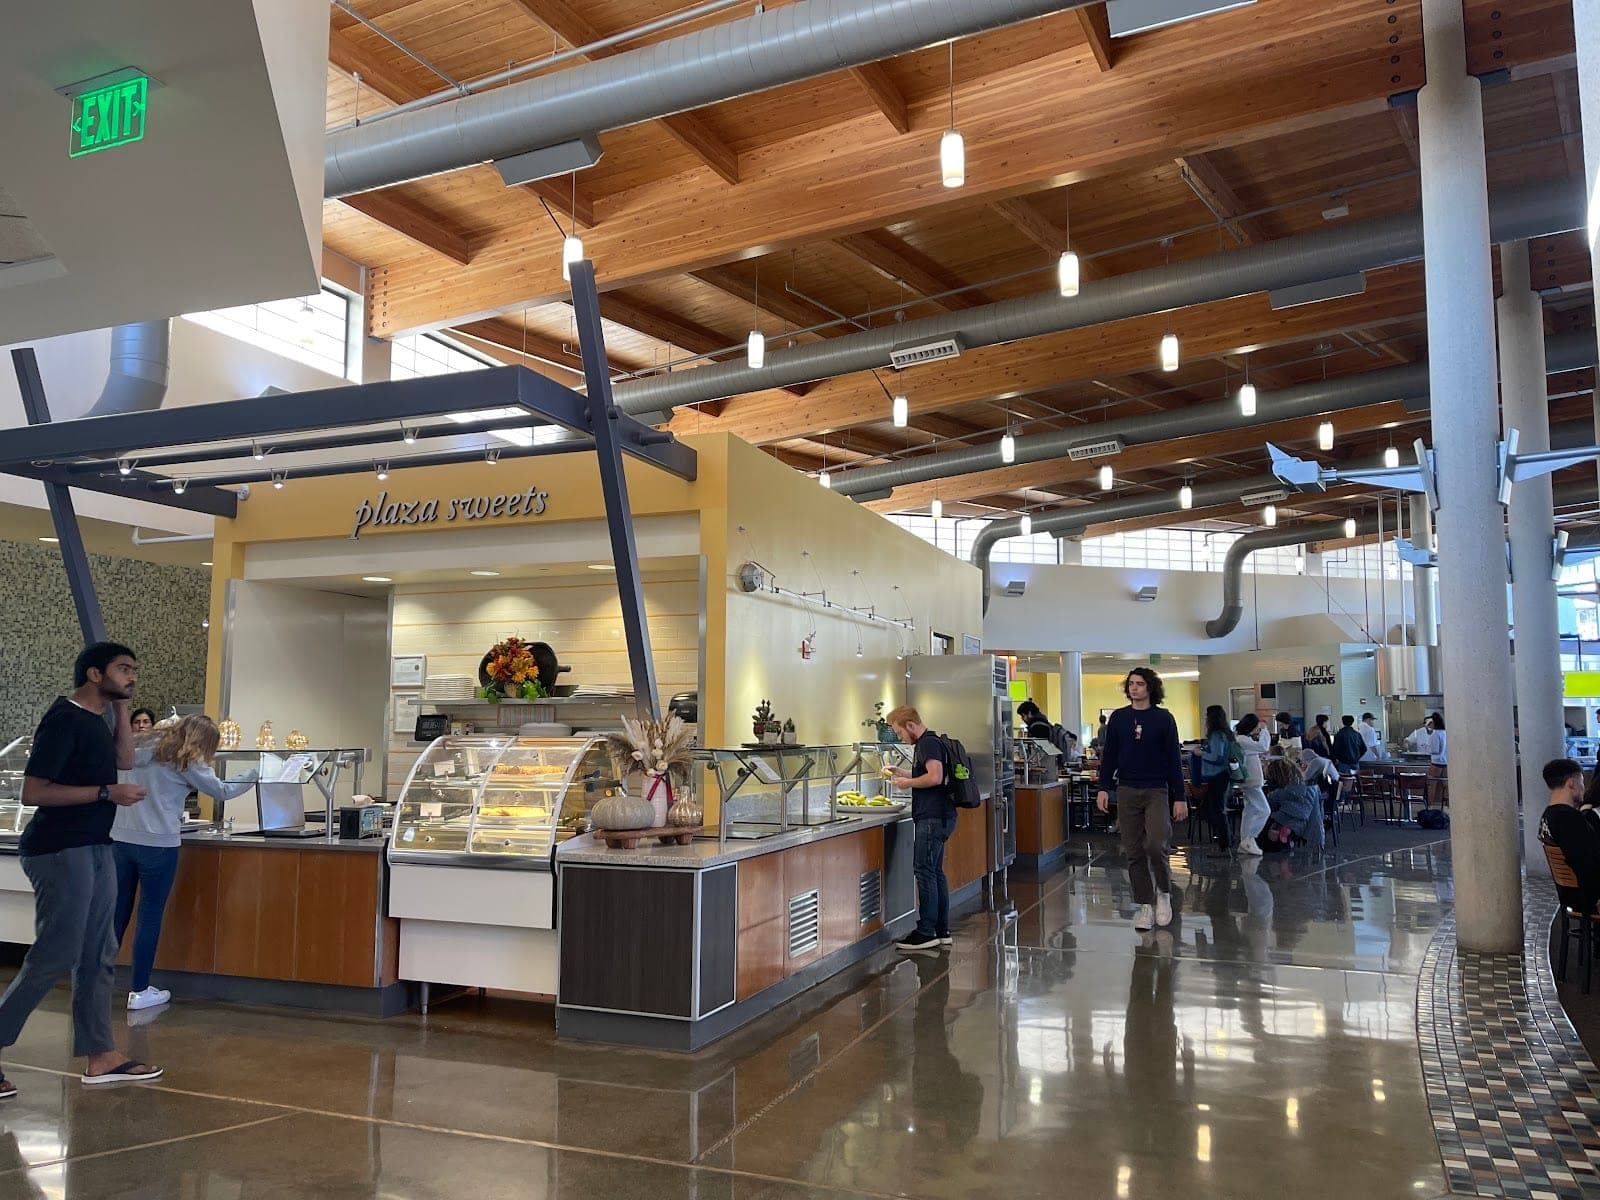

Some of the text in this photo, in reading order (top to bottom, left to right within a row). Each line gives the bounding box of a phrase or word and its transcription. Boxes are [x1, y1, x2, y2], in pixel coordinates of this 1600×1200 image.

[81, 84, 137, 147] EXIT
[348, 485, 549, 540] plaza sweets
[1303, 665, 1335, 677] PACIFIC
[1303, 677, 1335, 685] FUSIONS
